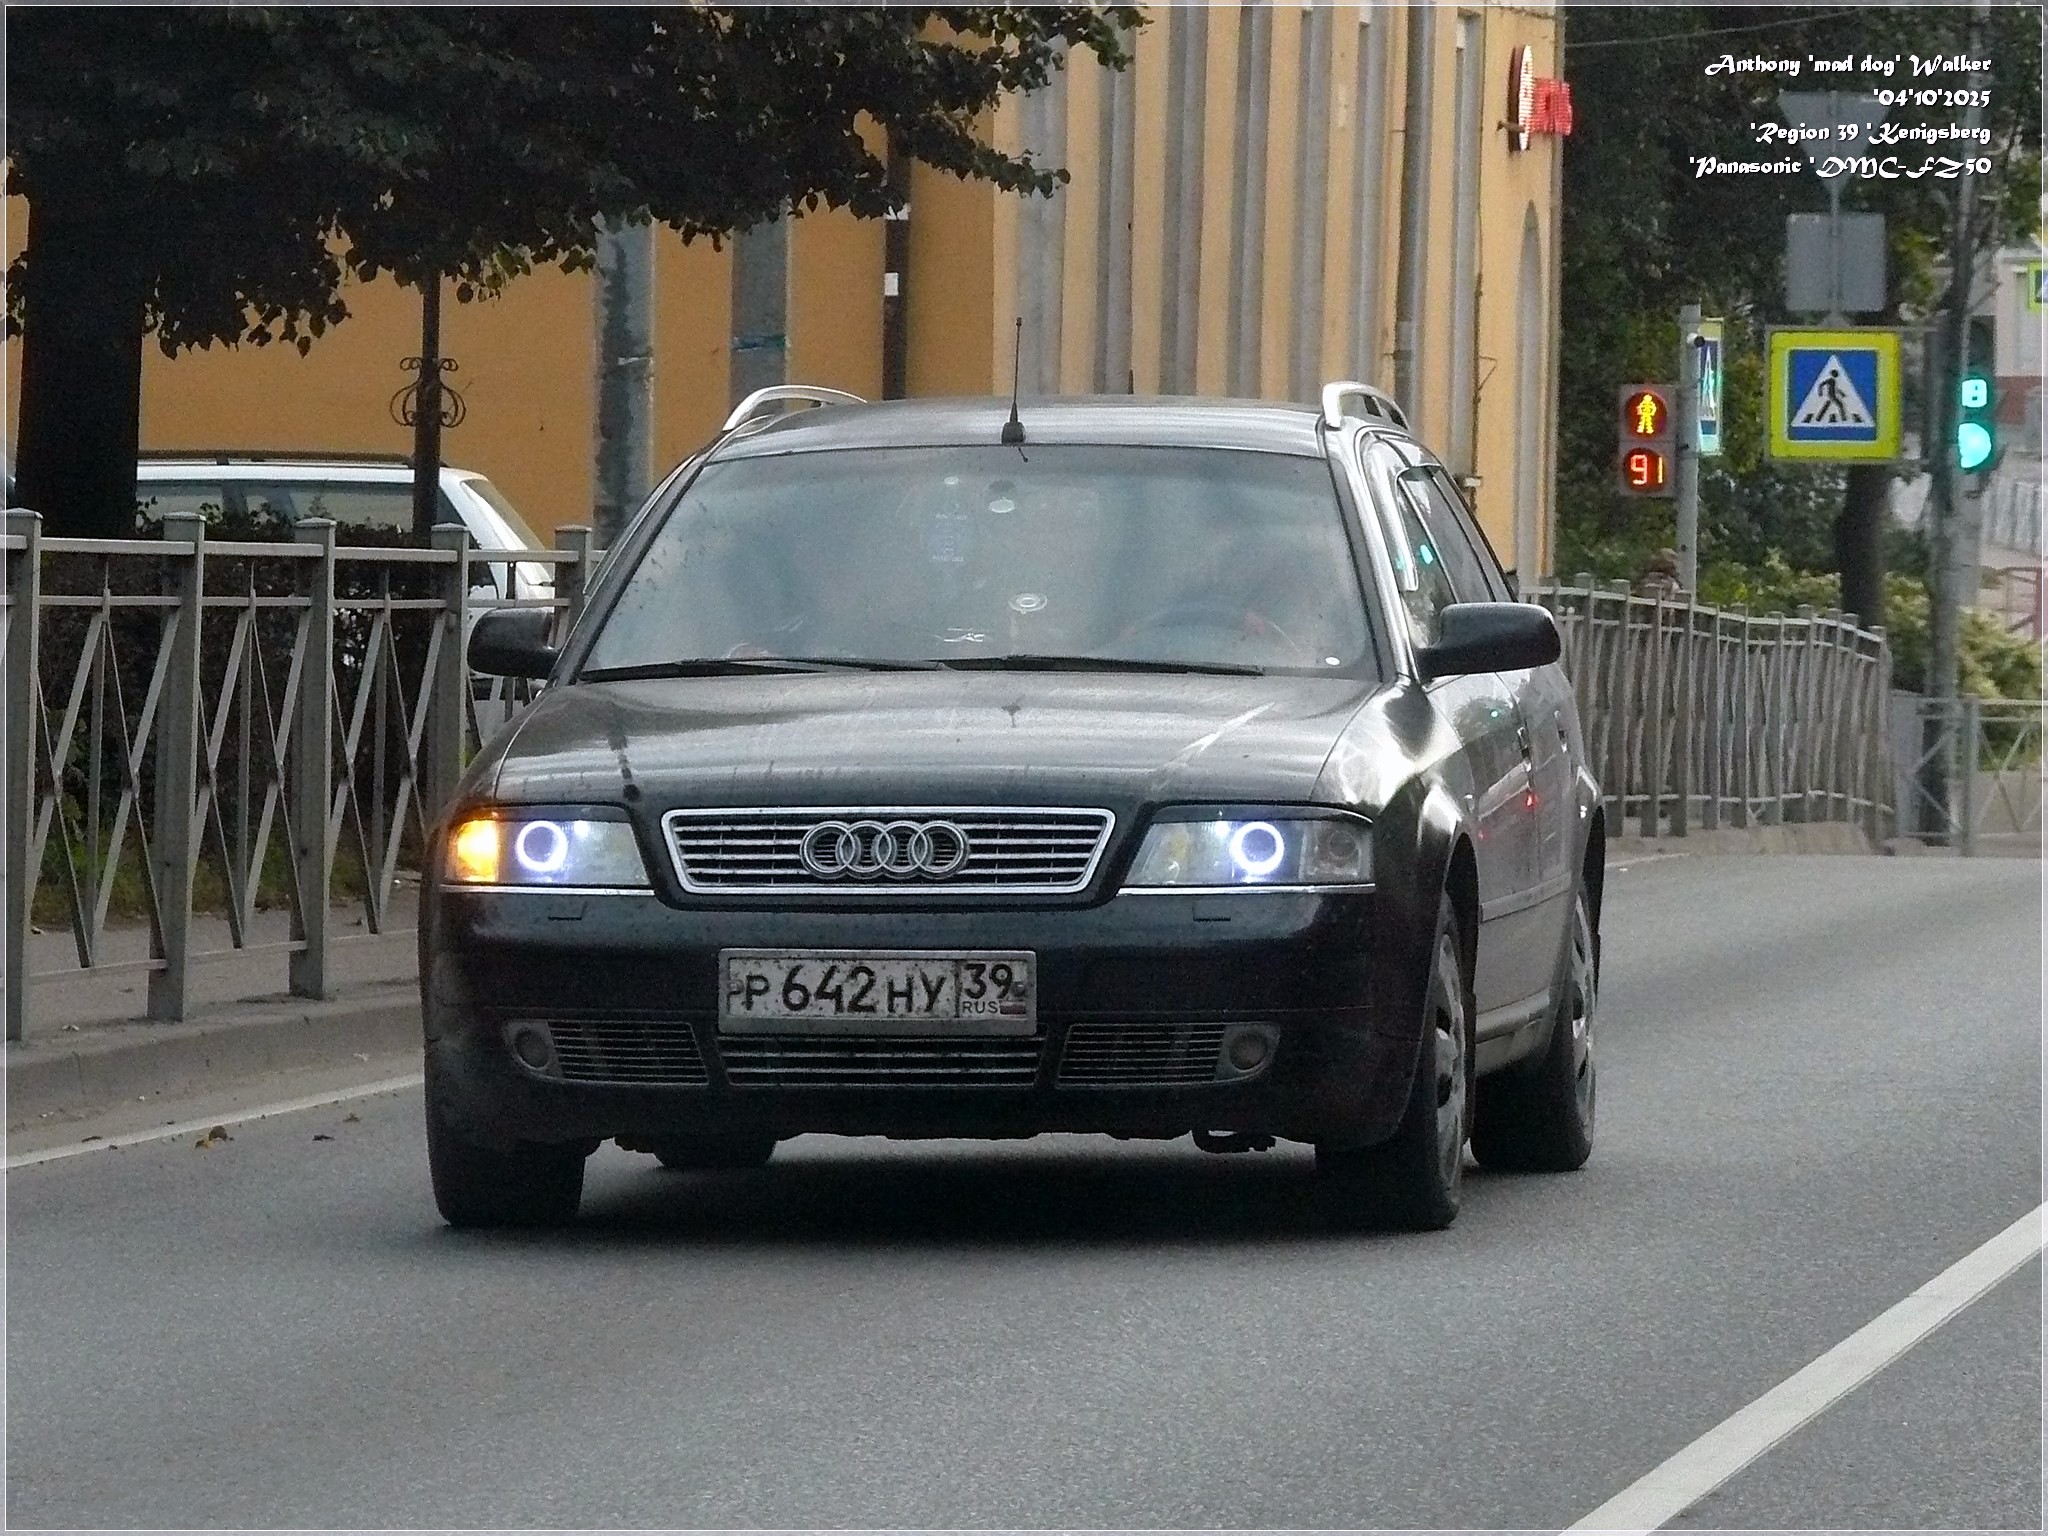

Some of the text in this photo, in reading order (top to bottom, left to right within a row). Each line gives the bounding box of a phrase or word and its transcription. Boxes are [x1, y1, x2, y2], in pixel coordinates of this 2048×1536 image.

[1630, 454, 1664, 485] 91
[963, 963, 1014, 1000] 39
[962, 1001, 999, 1015] RUS
